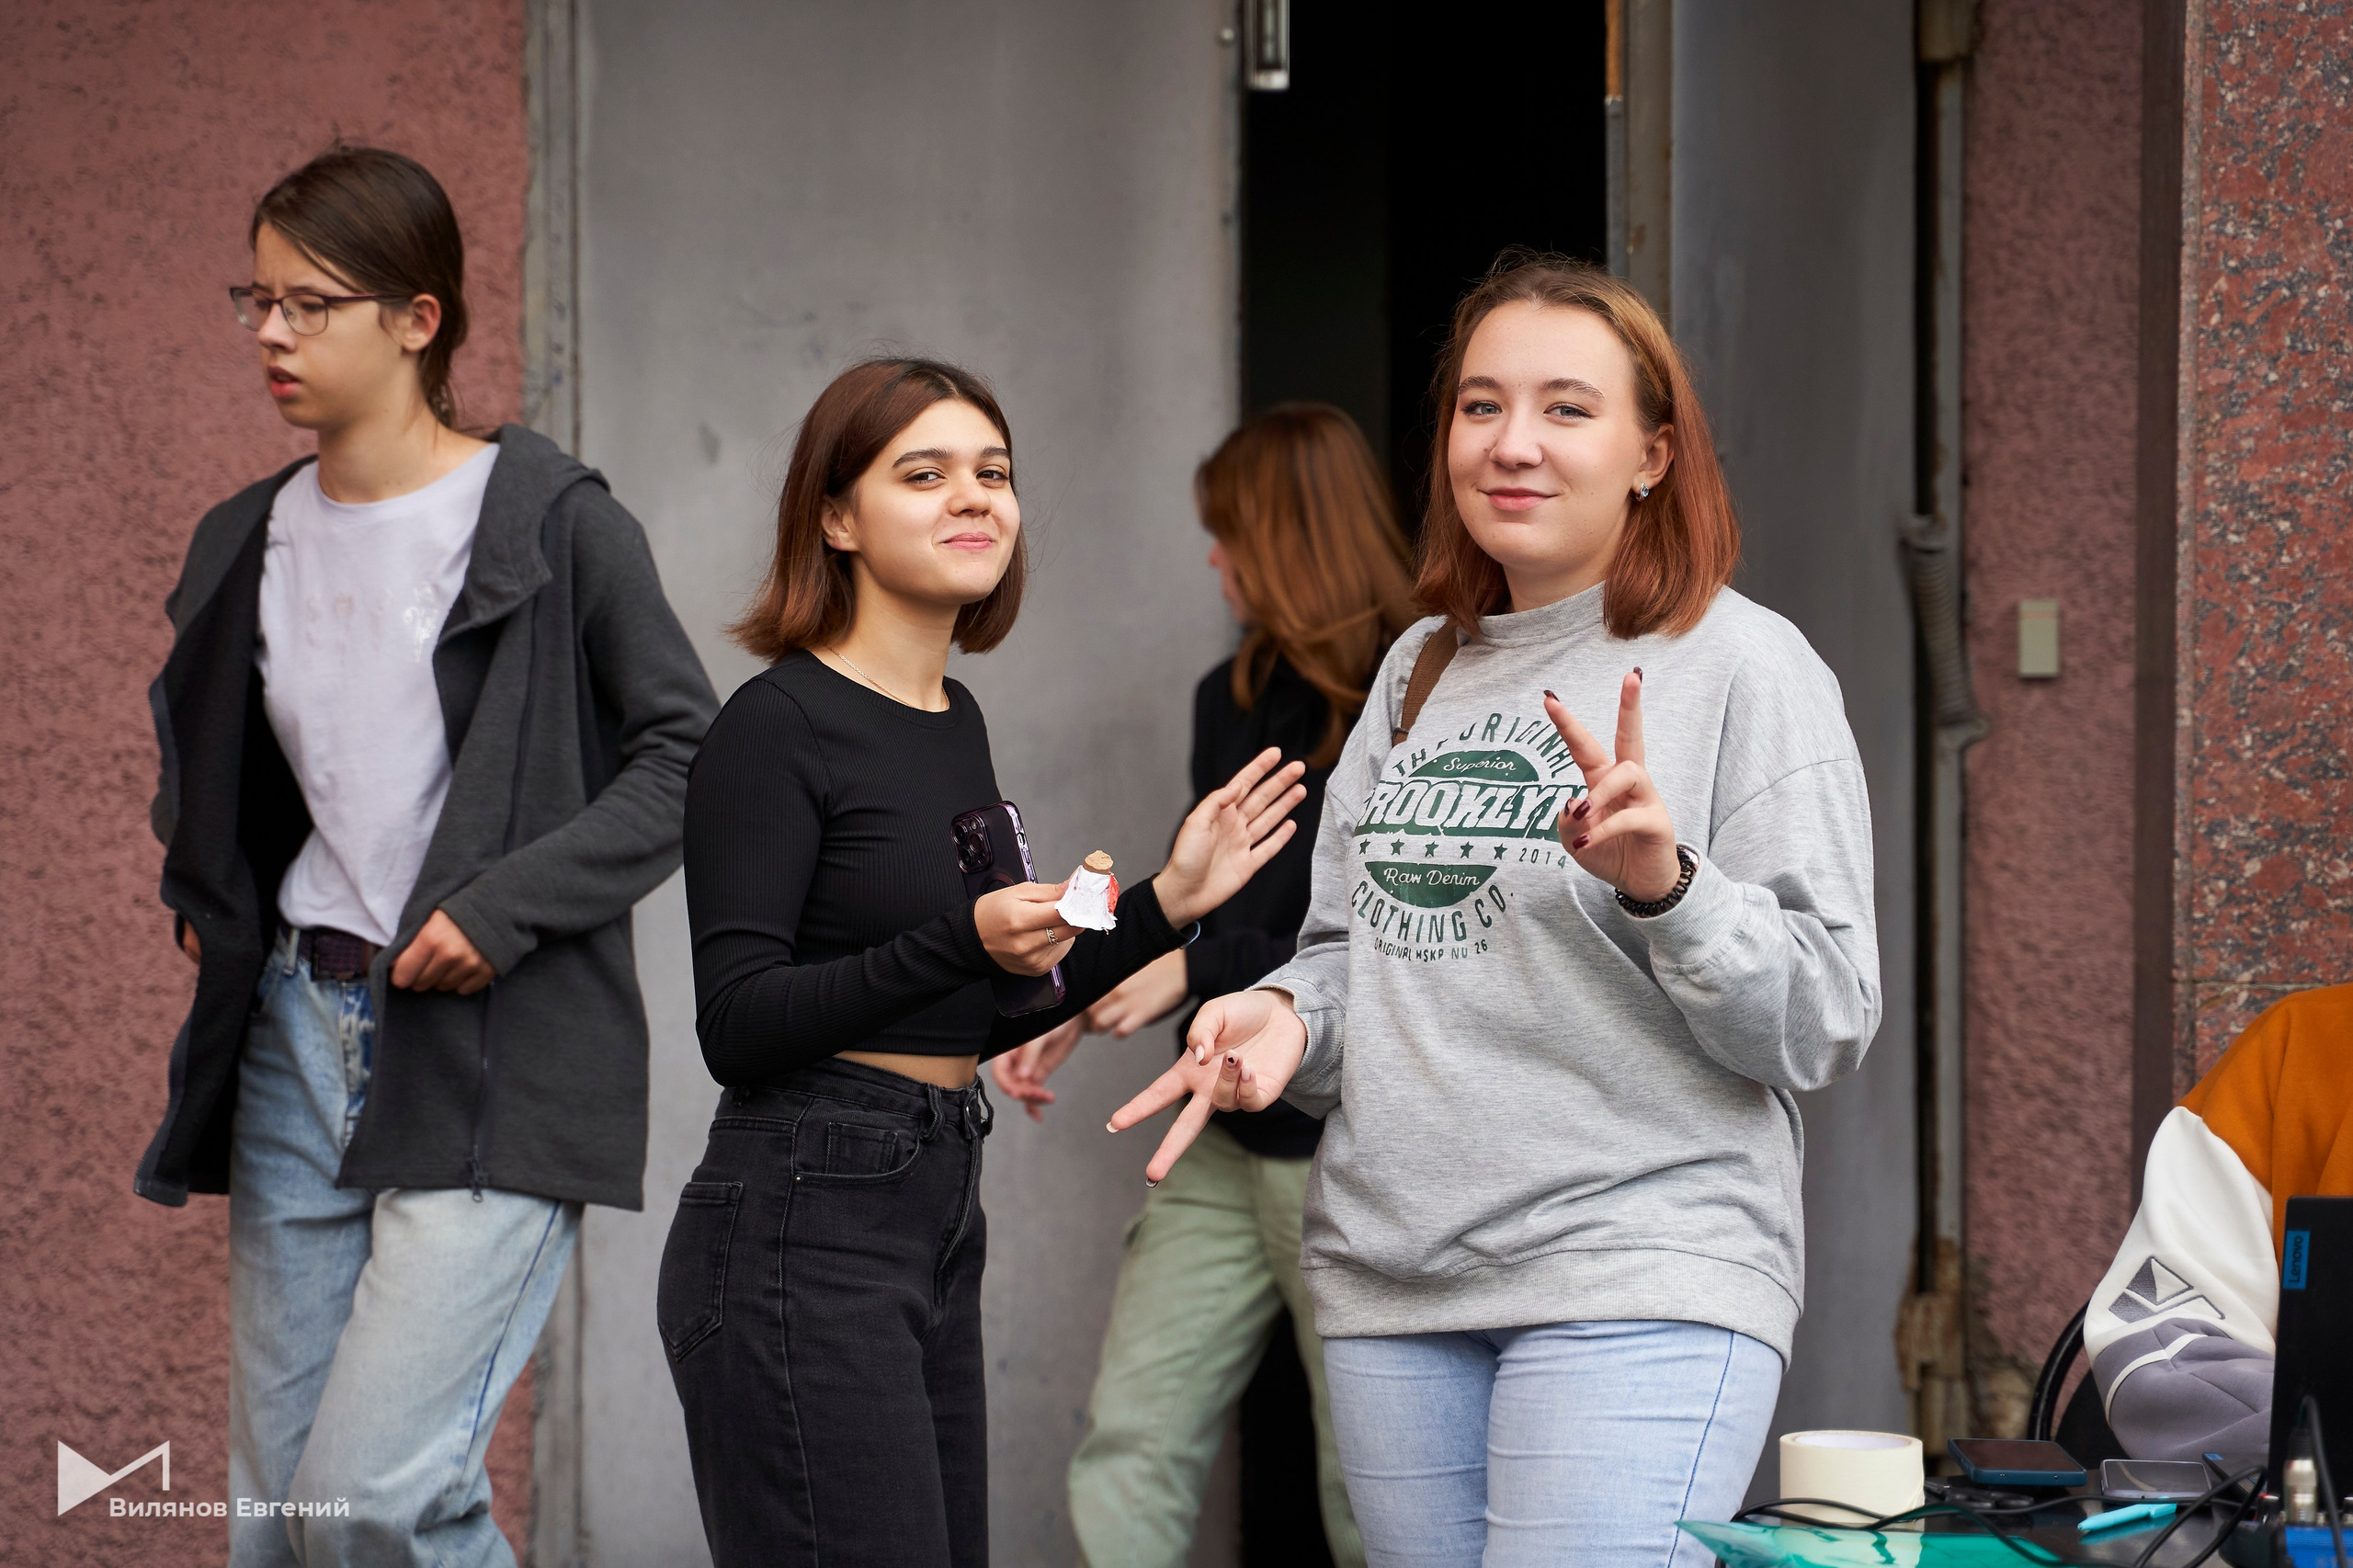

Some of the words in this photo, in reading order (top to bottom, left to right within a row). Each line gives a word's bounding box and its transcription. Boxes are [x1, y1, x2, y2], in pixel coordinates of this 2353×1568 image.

[1443, 757, 1517, 773] Superior
[1518, 847, 1567, 869] 2014
[1384, 869, 1422, 883] Raw
[1427, 868, 1481, 887] Denim
[1351, 880, 1467, 943] CLOTHING
[1374, 937, 1411, 960] ORIGINAL
[1474, 938, 1488, 954] 26
[2288, 1235, 2303, 1284] Lenovo
